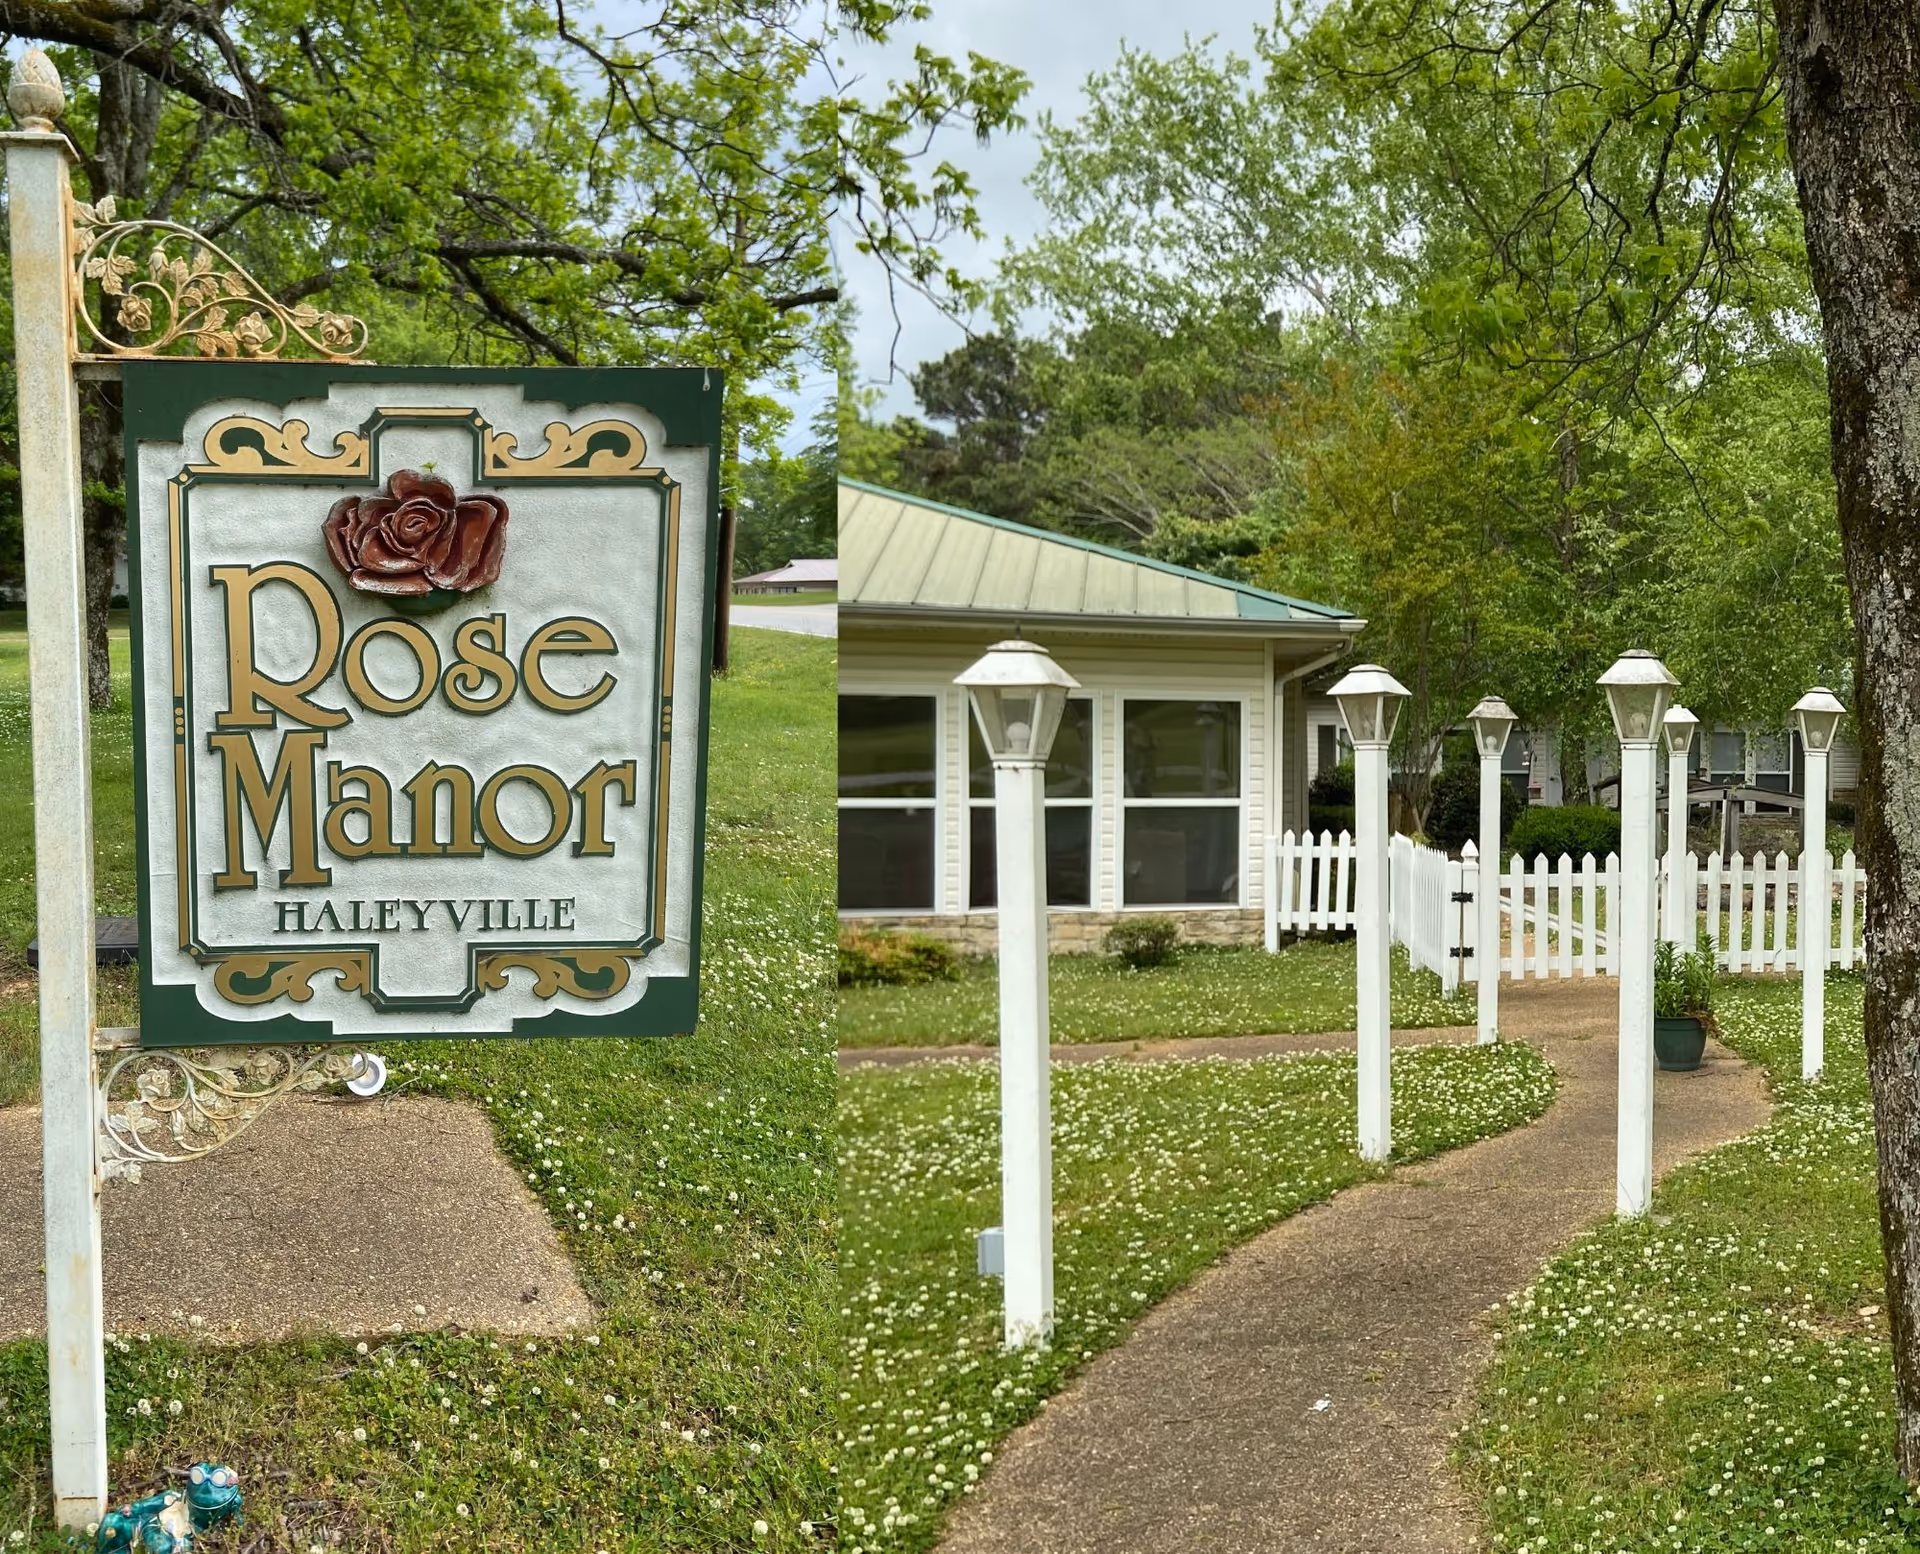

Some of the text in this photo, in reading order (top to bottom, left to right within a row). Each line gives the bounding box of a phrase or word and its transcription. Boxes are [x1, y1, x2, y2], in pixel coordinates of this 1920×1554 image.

[208, 562, 619, 730] Rose
[207, 730, 637, 890] Manor
[272, 896, 577, 934] HALEYVILLE
